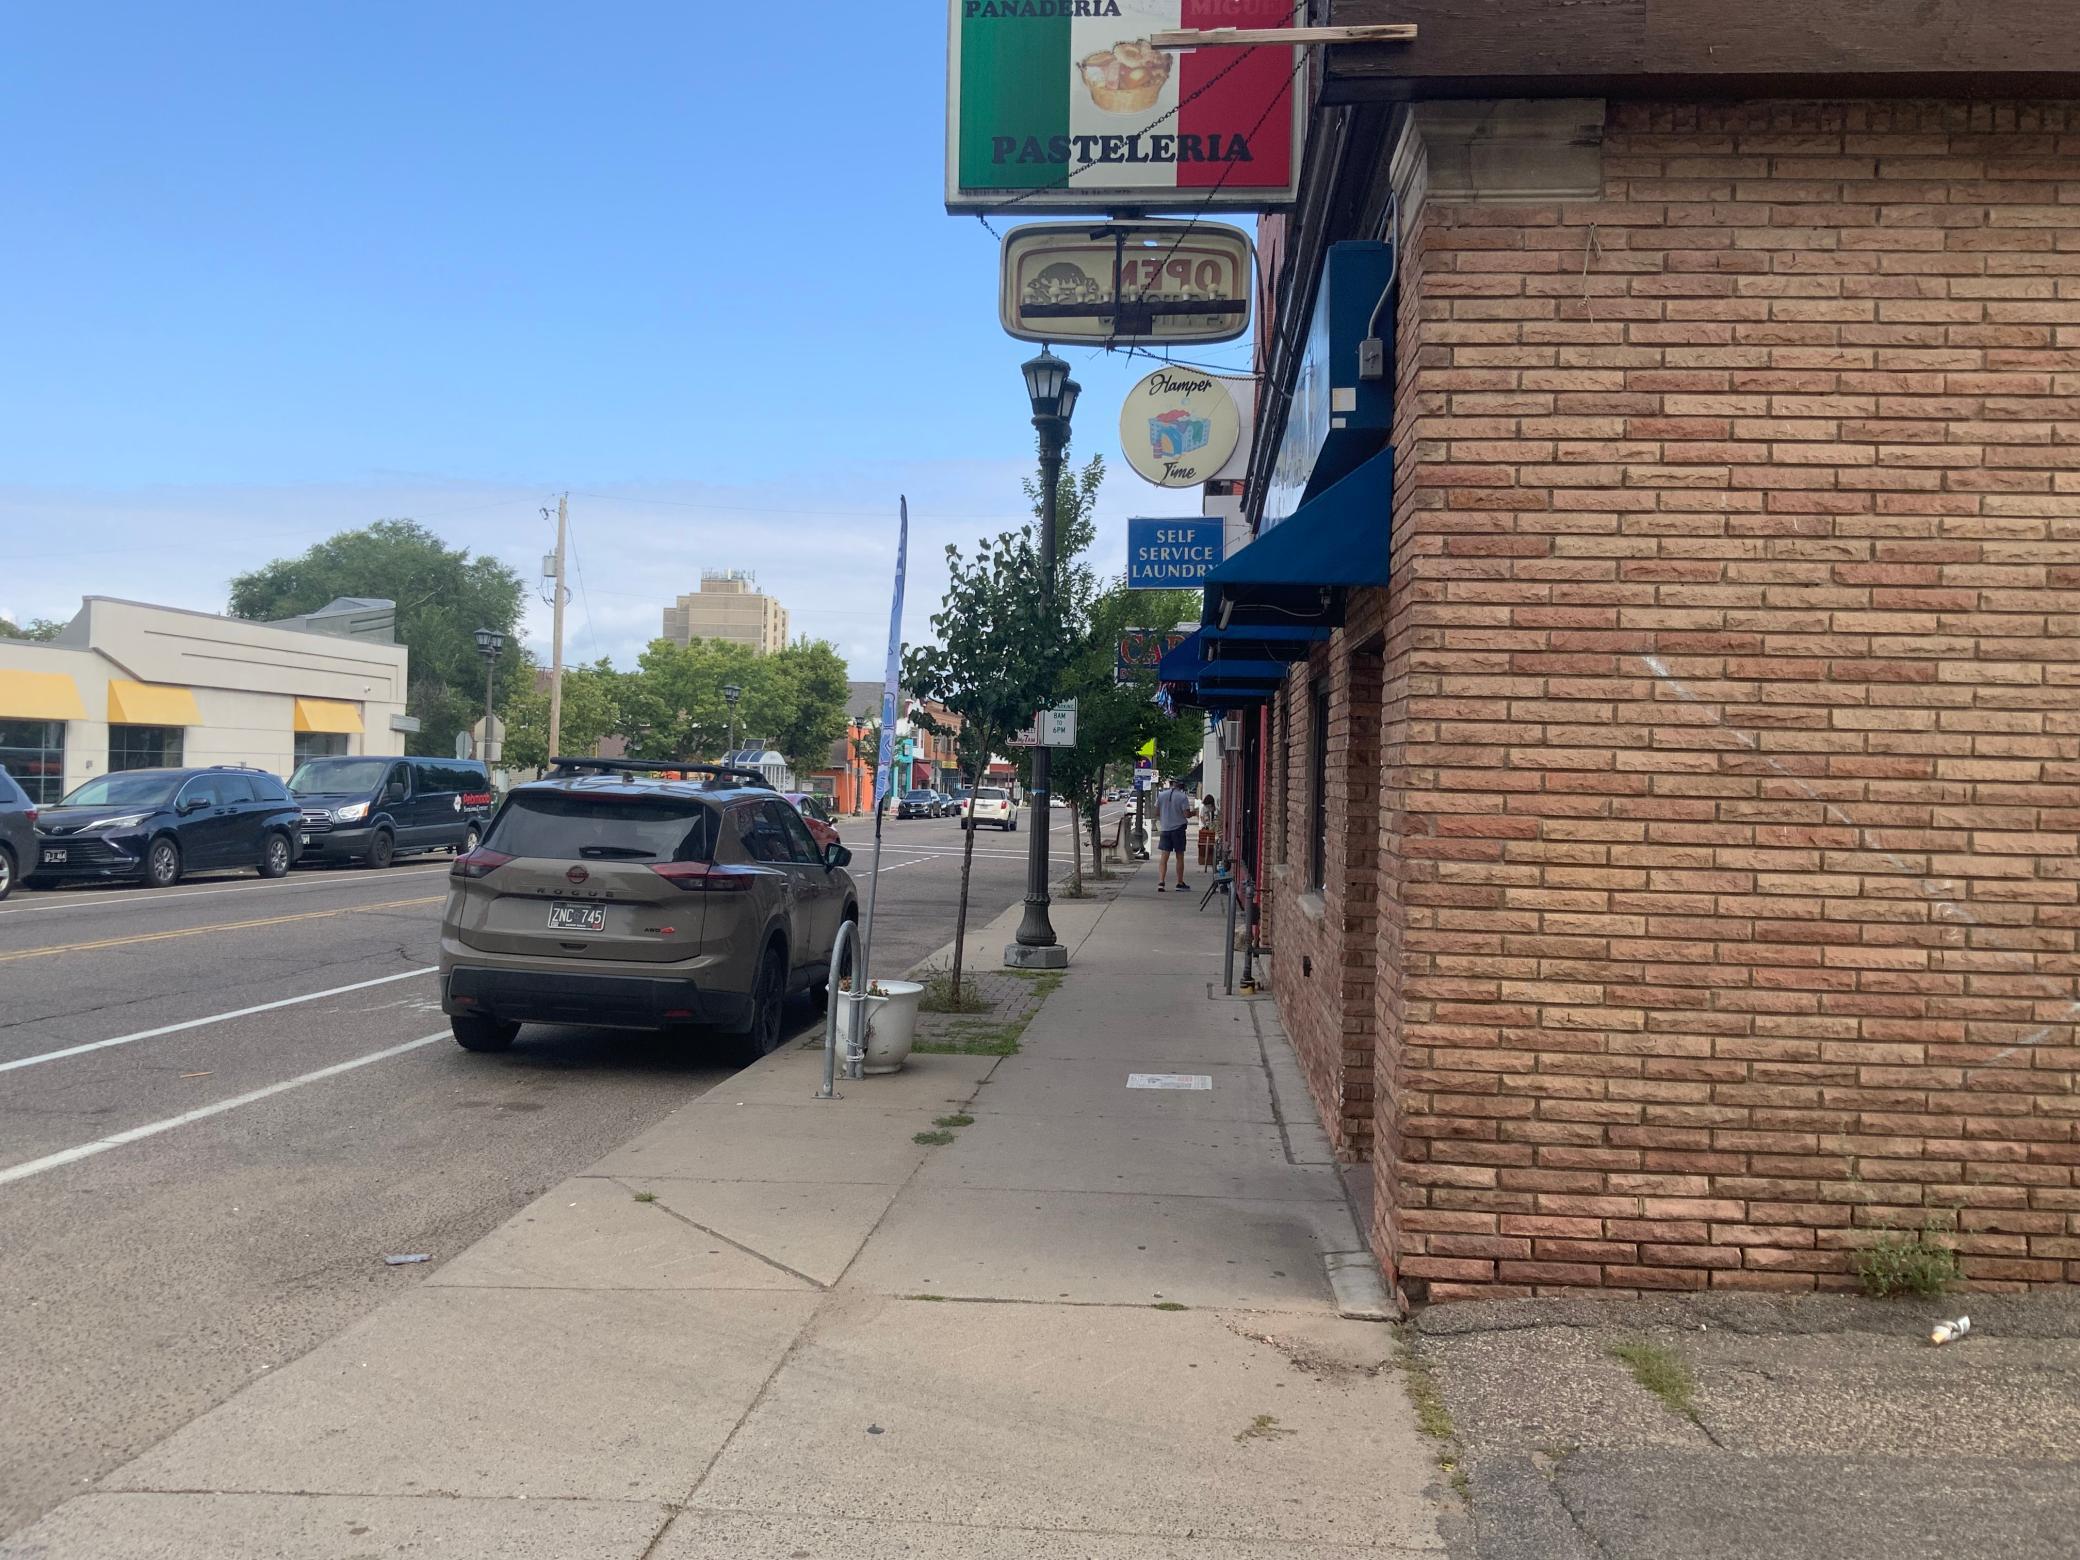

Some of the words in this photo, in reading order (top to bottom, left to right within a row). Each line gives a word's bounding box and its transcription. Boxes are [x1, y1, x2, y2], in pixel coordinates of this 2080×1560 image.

[965, 0, 1121, 18] PANADERIA
[991, 134, 1254, 164] PASTELERIA
[1149, 374, 1212, 397] Hamper
[1162, 461, 1197, 480] Time
[1156, 529, 1196, 543] SELF
[1139, 546, 1213, 561] SERVICE
[536, 887, 614, 898] ROGUE
[551, 907, 574, 923] ZNC
[581, 909, 602, 924] 745
